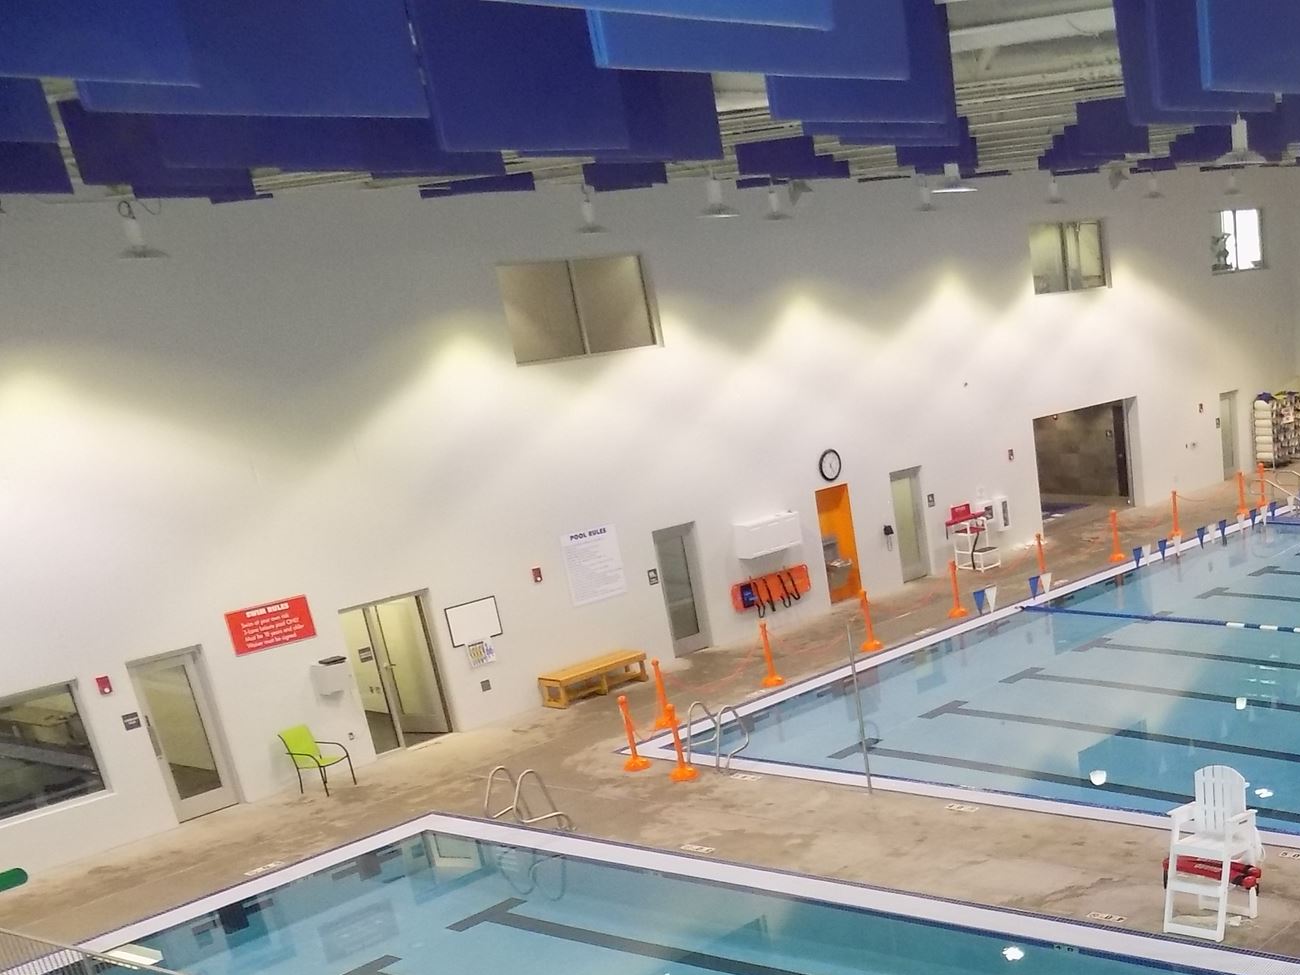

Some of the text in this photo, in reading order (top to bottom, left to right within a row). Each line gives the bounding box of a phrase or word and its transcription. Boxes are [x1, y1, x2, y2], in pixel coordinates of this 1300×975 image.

[569, 527, 607, 541] POOL RULES
[266, 602, 290, 613] RULES
